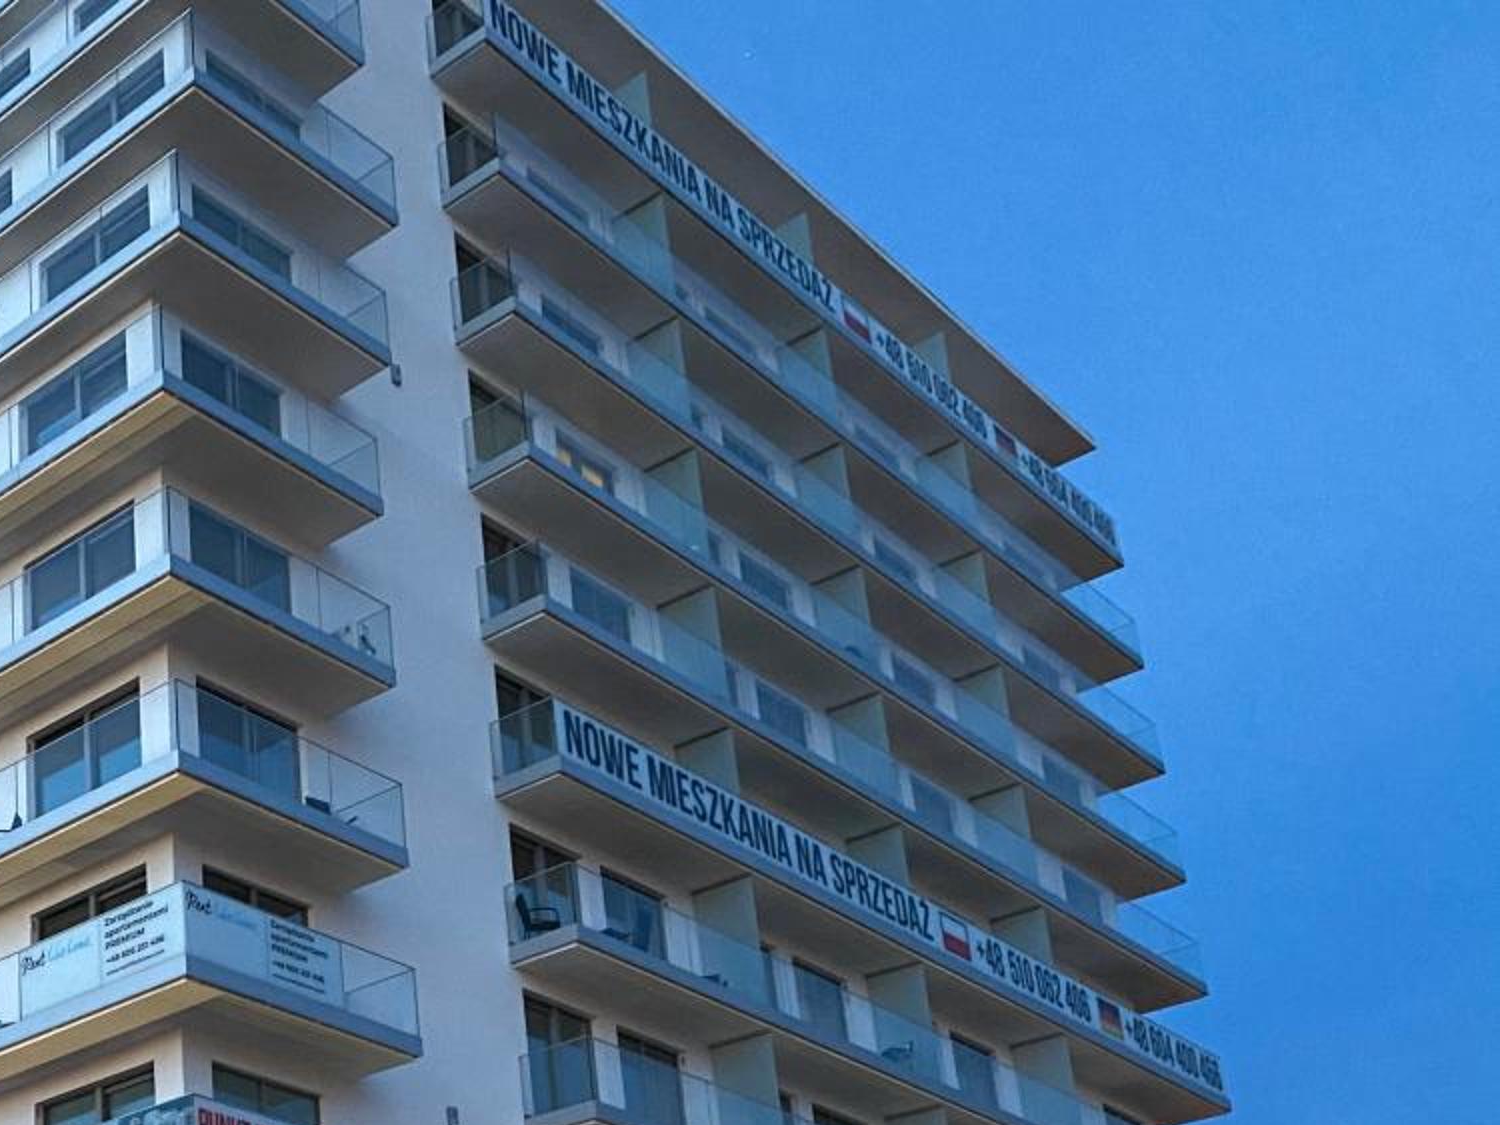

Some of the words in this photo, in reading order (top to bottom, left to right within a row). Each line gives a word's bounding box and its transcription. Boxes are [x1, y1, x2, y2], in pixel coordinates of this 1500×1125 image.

[490, 0, 562, 85] NOWE
[566, 60, 701, 202] MIESZKANIA
[704, 178, 736, 230] NA
[563, 708, 643, 790] NOWE
[646, 752, 793, 868] MIESZKANIA
[794, 833, 828, 887] NA
[976, 938, 1005, 978] +48
[1007, 949, 1035, 993] 510
